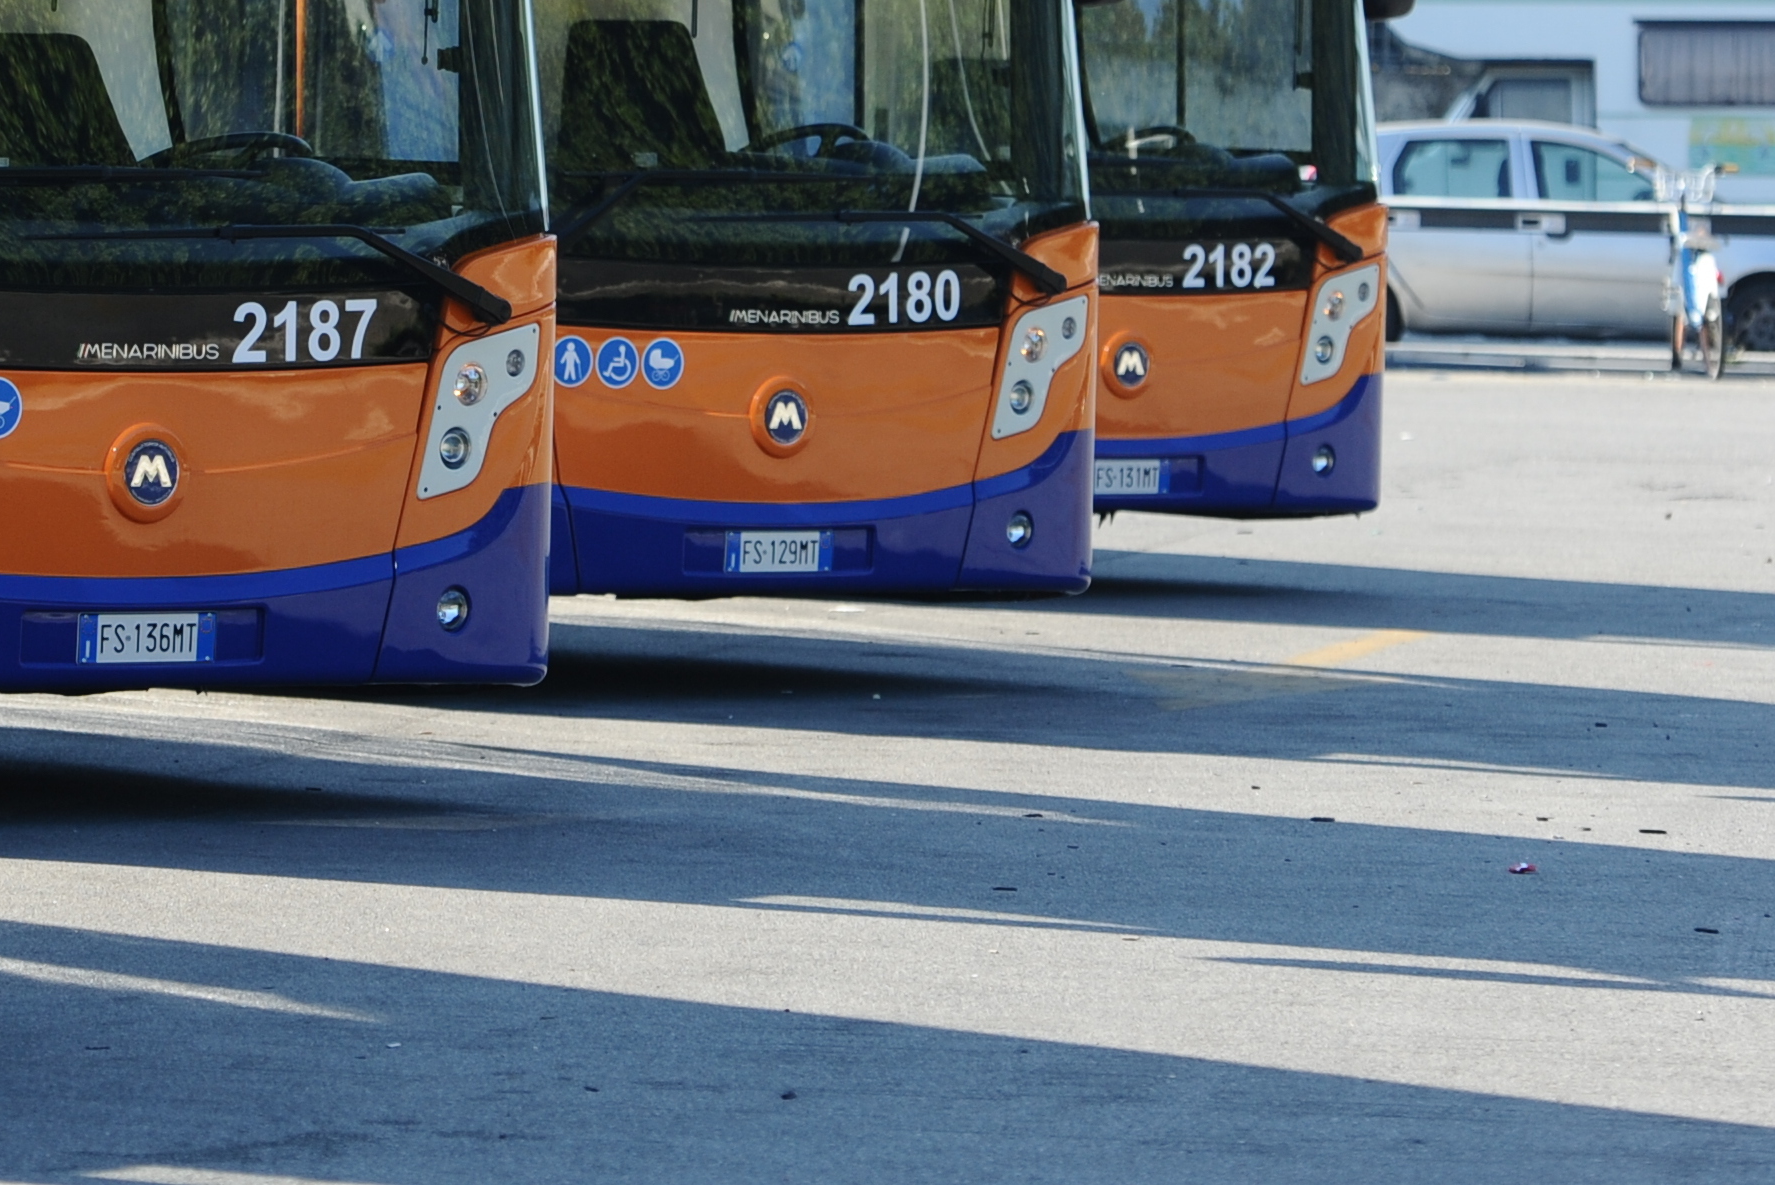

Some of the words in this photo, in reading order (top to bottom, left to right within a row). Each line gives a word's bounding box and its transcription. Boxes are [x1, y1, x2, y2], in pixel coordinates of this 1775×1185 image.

[1181, 242, 1276, 289] 2182
[846, 269, 961, 327] 2180
[231, 298, 378, 364] 2187
